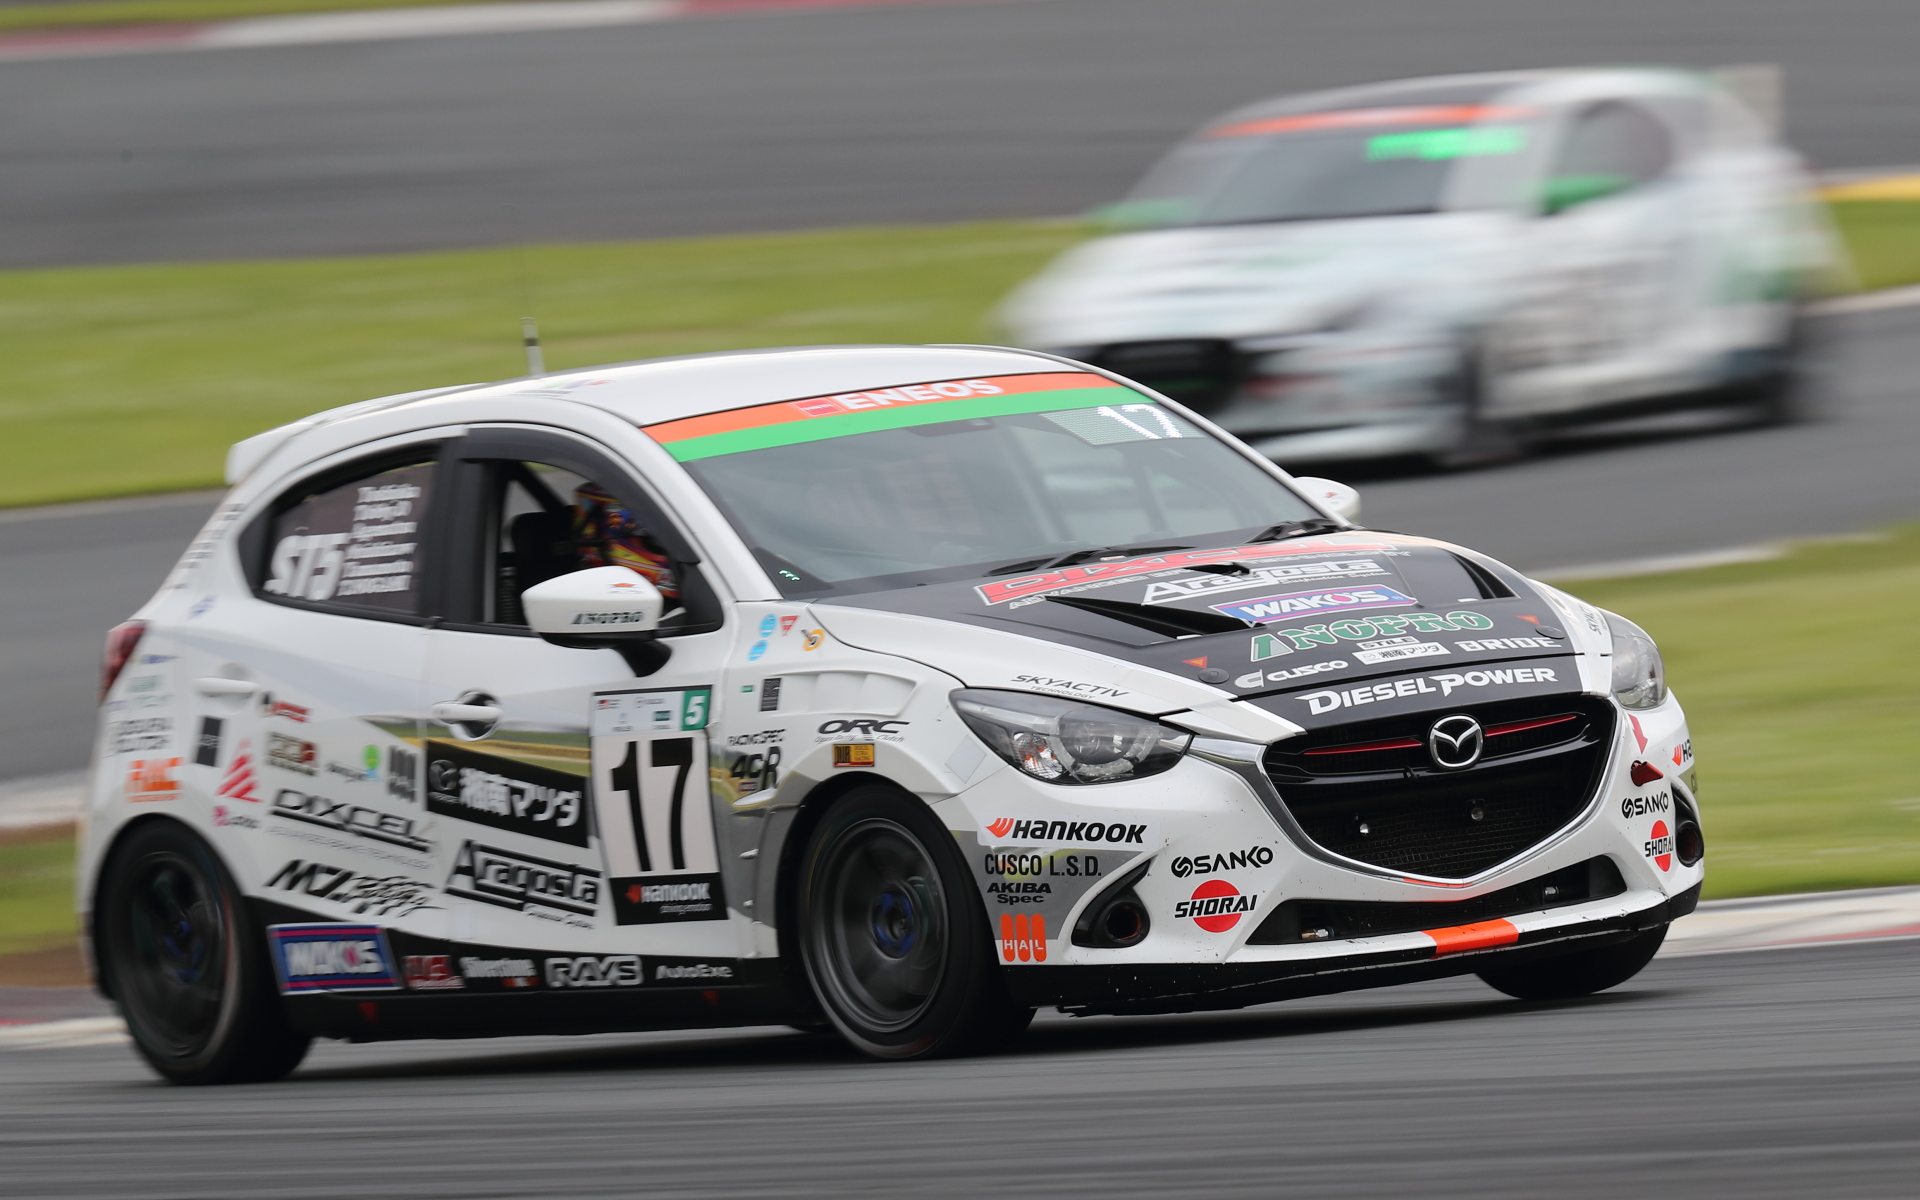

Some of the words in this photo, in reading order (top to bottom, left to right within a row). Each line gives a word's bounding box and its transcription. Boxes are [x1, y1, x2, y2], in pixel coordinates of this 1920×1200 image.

[834, 379, 1004, 410] ENEOS
[1097, 404, 1182, 439] 17
[263, 533, 349, 600] ST5
[974, 541, 1397, 606] DIXCEL
[1362, 635, 1417, 648] STILE
[1454, 637, 1563, 652] BRIDE
[1266, 660, 1349, 682] CUSCO
[1010, 674, 1131, 697] SKYACTIV
[1029, 685, 1098, 699] TECHNOLOGY
[1295, 677, 1437, 715] DIESEL
[1429, 668, 1558, 697] POWER
[683, 695, 706, 726] 5
[817, 719, 911, 734] ORC
[459, 766, 582, 828] 湘南マツダ
[611, 736, 694, 872] 17
[1634, 791, 1669, 817] SANKO
[268, 787, 436, 852] DIXCEL
[1012, 819, 1147, 844] HANKOOK
[1644, 835, 1674, 858] SHORAI
[984, 853, 1043, 876] CUSCO
[1049, 855, 1102, 877] L.S.D.
[1193, 845, 1274, 875] SANKO
[986, 882, 1052, 894] AKIBA
[997, 893, 1045, 906] Spec
[1174, 894, 1258, 919] SHORAI
[1003, 938, 1044, 951] HAL
[545, 955, 644, 987] RAYS
[655, 964, 733, 980] AutoExe
